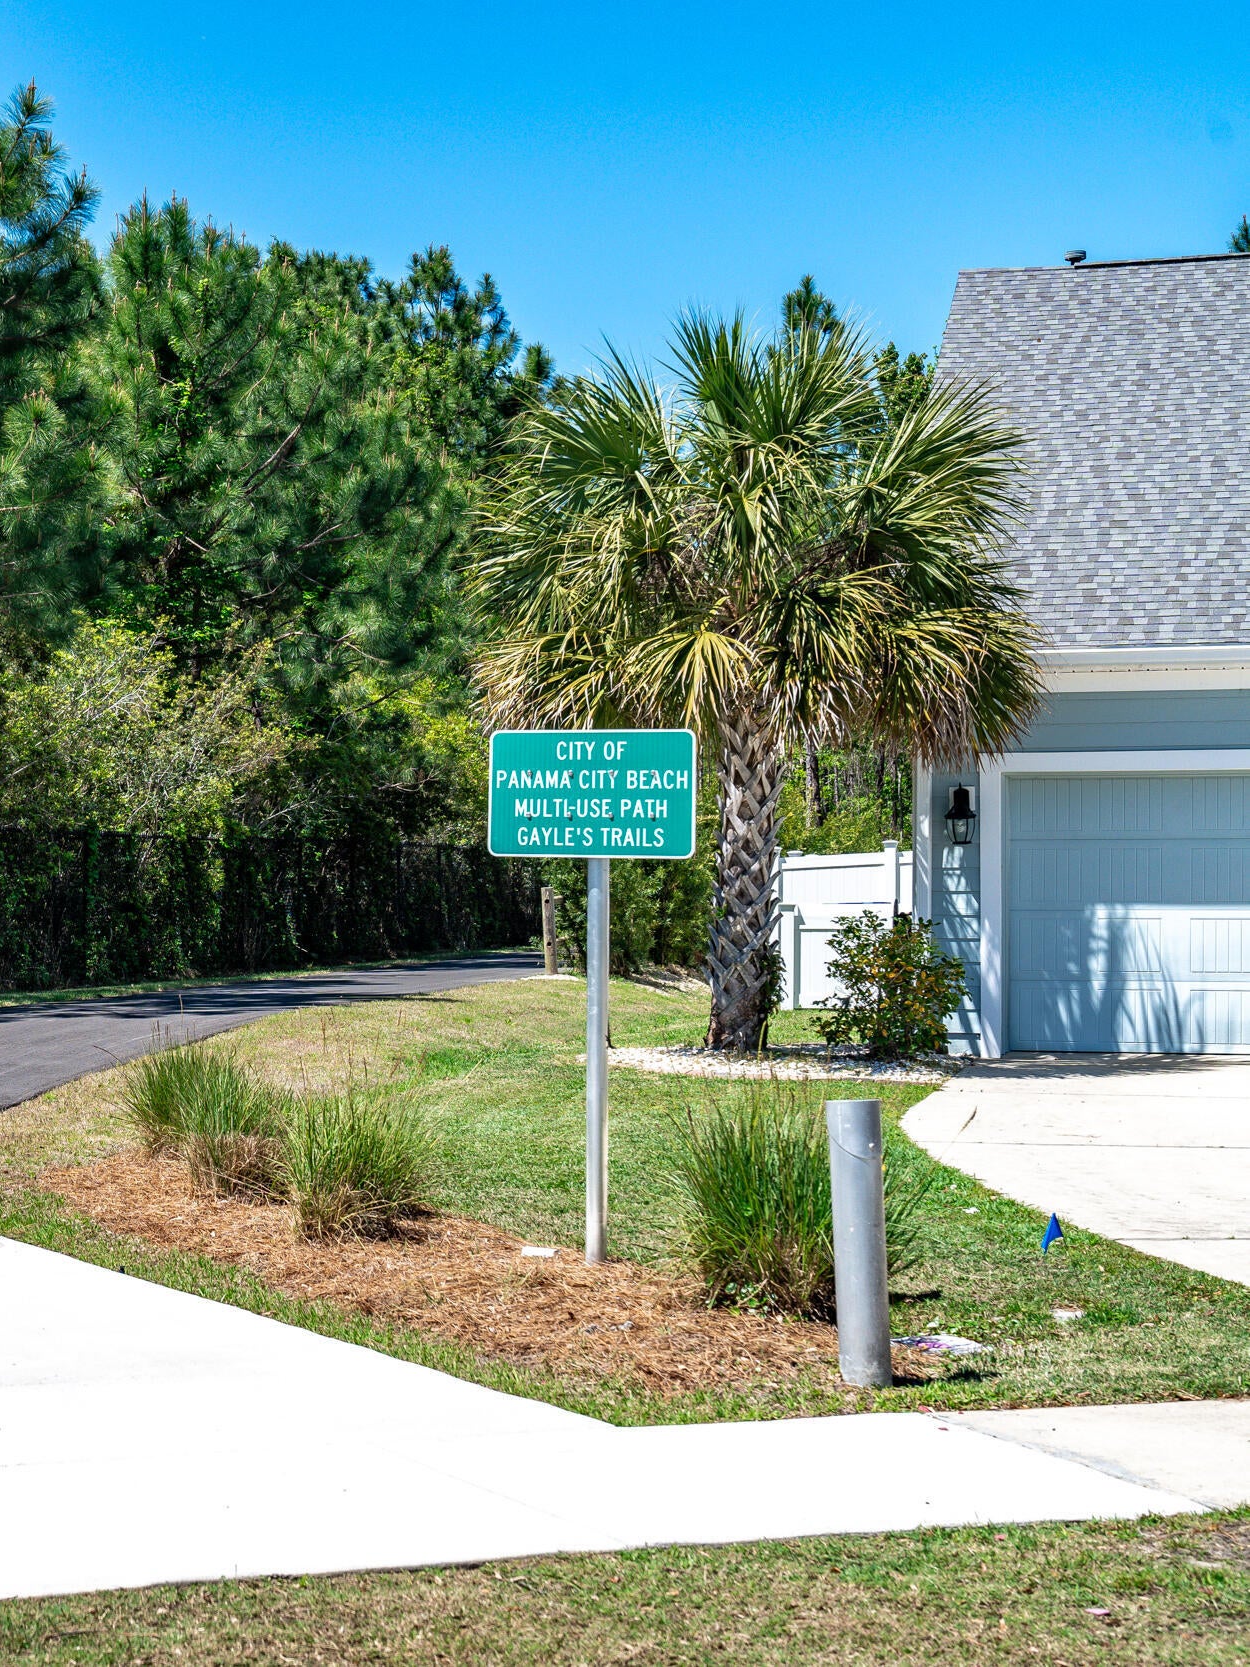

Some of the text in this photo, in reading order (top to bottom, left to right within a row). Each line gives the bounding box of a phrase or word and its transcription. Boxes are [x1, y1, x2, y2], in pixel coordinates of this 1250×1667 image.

[556, 741, 627, 760] CITY OF
[496, 770, 688, 789] PANAMA CITY BEACH
[515, 799, 667, 818] MULTI-USE PATH
[517, 827, 664, 847] GAYLE'S TRAILS
